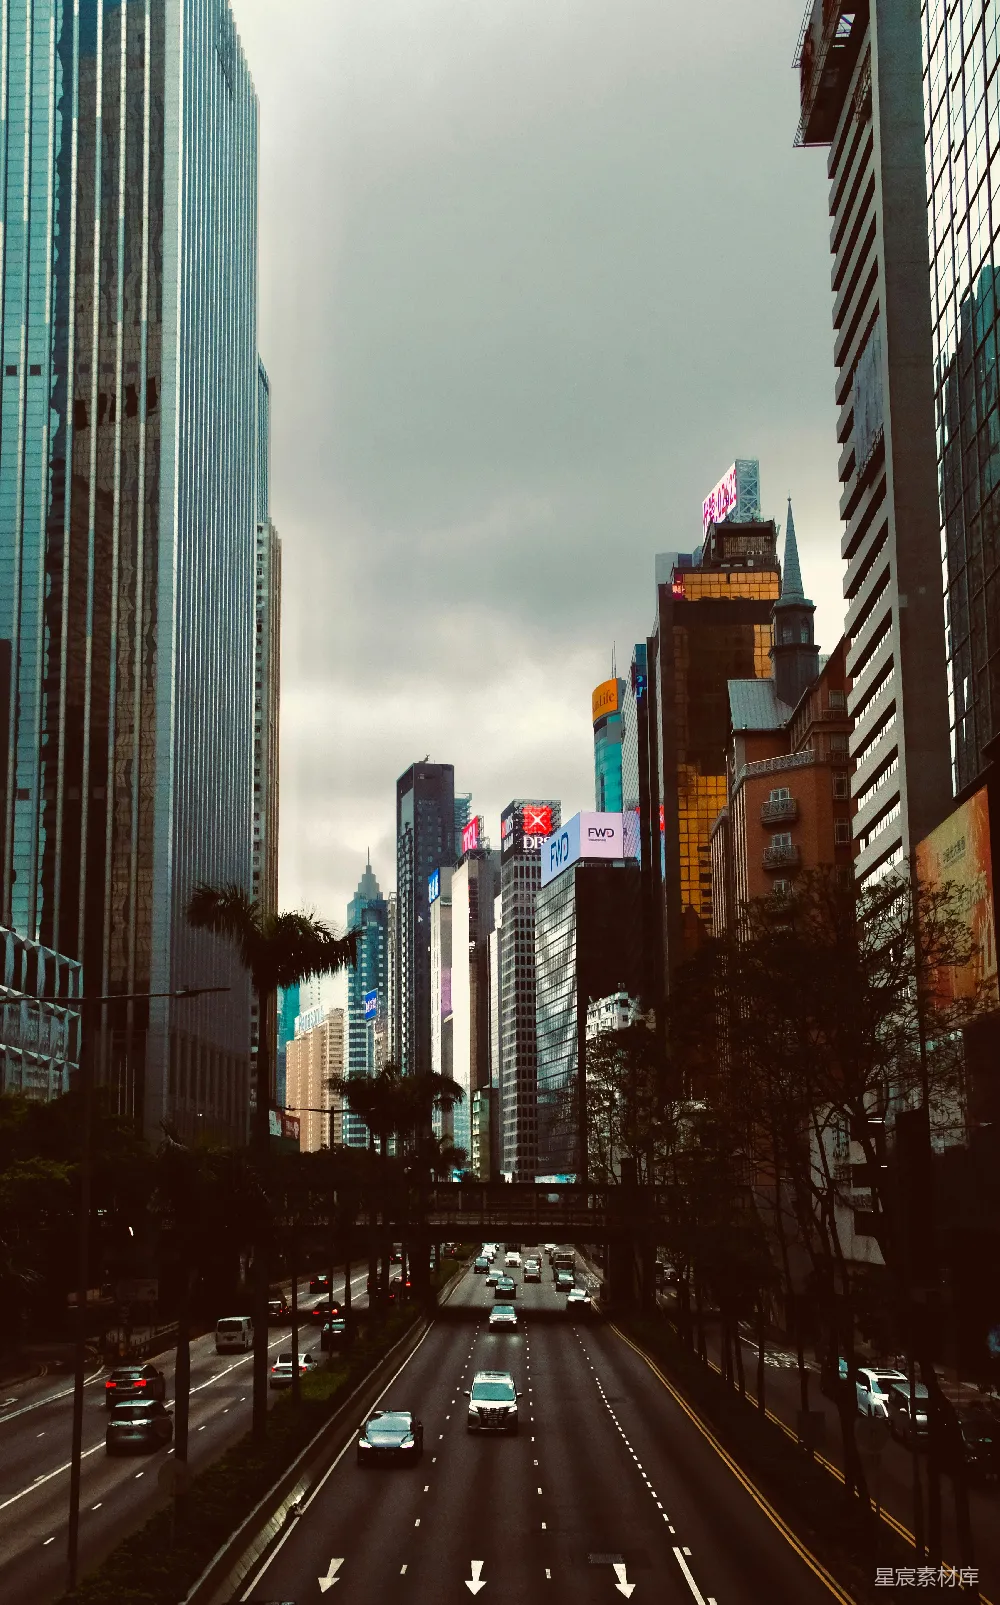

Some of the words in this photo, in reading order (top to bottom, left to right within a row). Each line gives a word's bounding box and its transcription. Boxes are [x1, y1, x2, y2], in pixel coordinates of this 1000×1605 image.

[599, 689, 615, 706] Life
[463, 823, 477, 852] TCL
[588, 828, 614, 838] FWD
[550, 831, 569, 872] FWD
